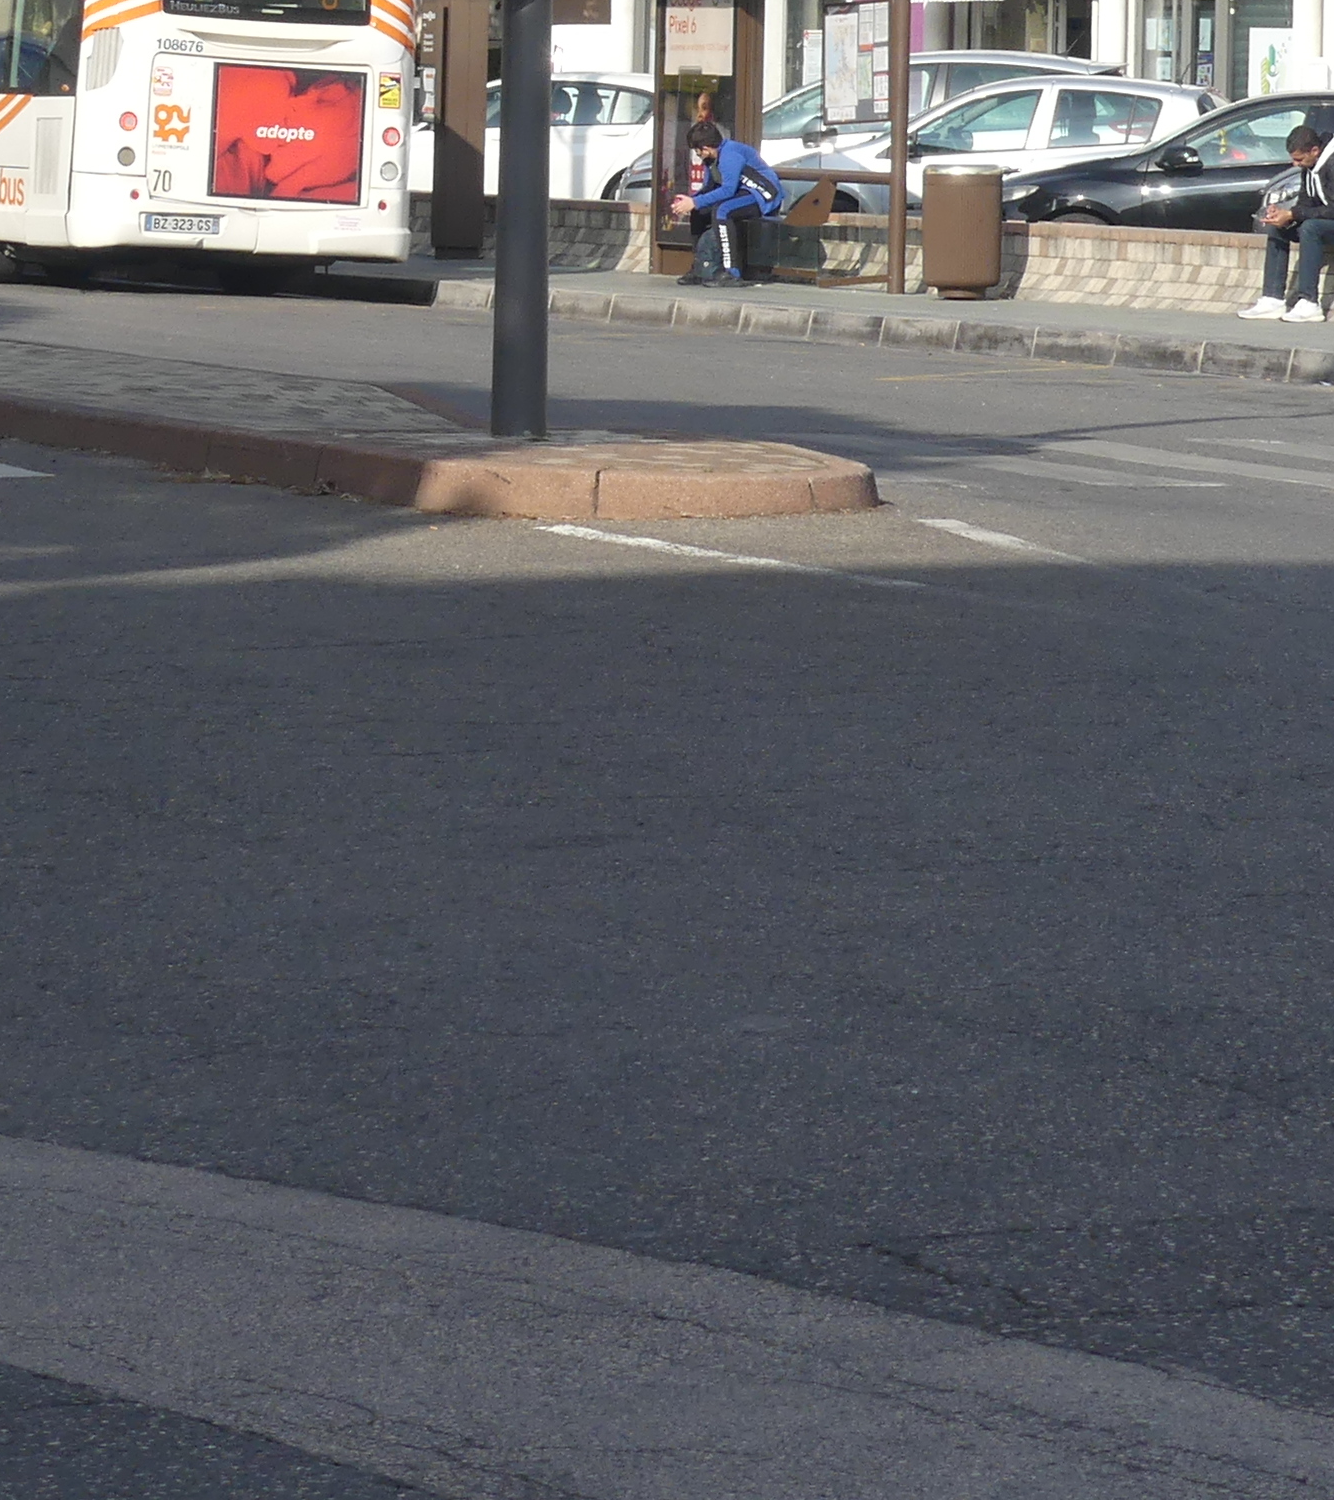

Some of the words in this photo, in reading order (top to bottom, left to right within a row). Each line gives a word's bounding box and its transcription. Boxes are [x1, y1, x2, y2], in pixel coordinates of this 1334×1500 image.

[669, 15, 689, 34] Pixel
[691, 16, 697, 34] 6
[156, 38, 204, 53] 108676
[255, 124, 315, 143] adopte
[153, 169, 173, 194] 70
